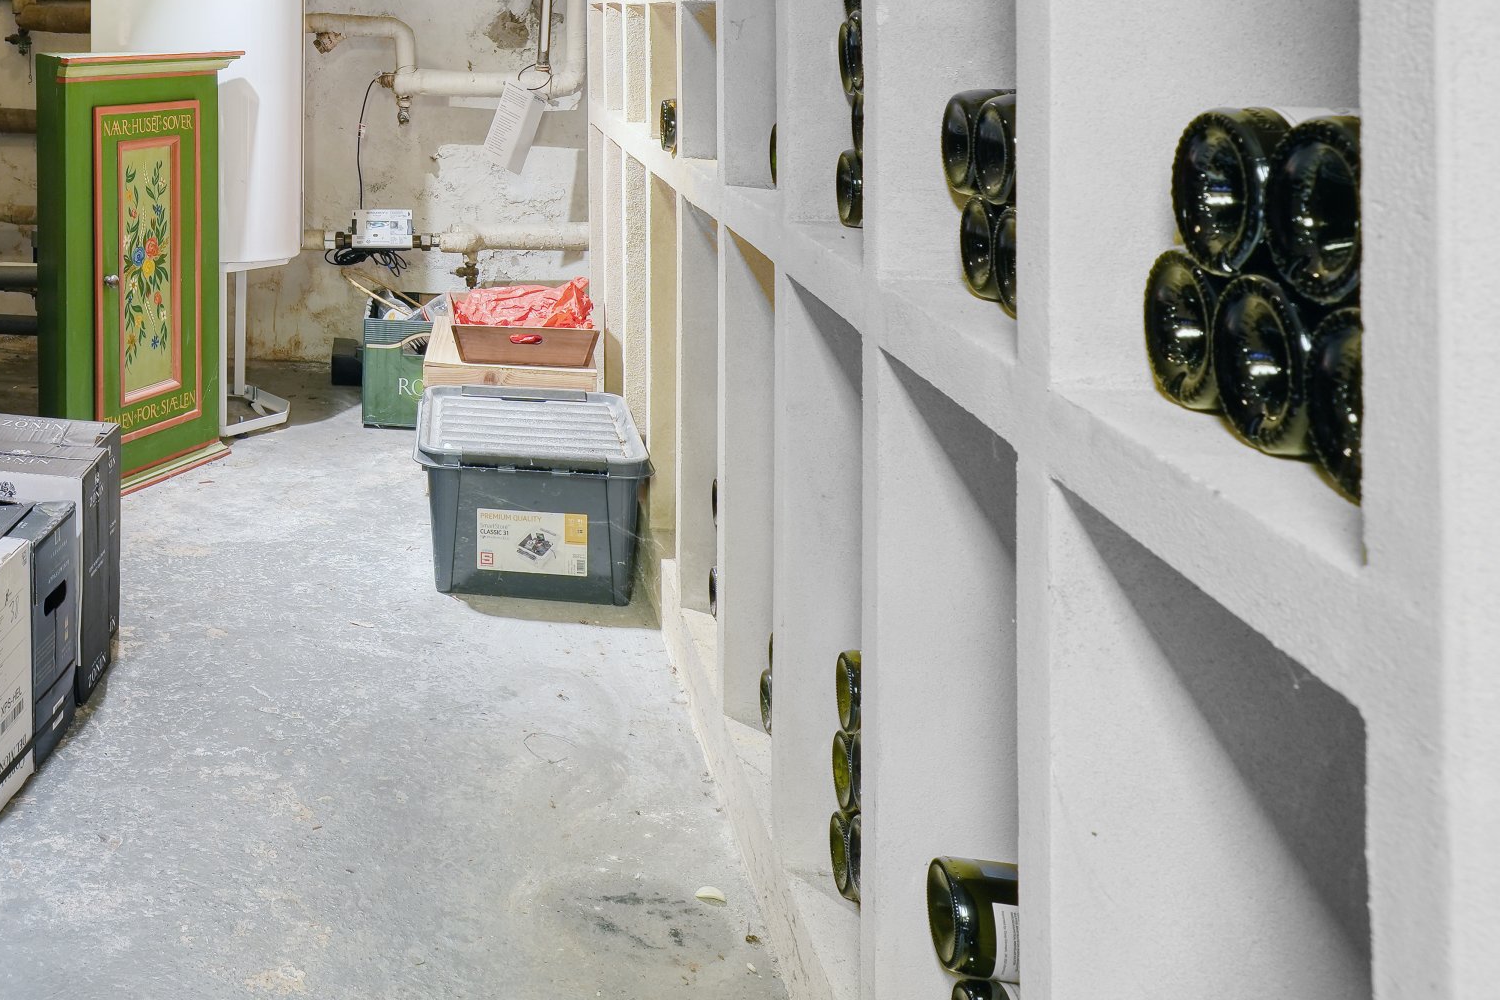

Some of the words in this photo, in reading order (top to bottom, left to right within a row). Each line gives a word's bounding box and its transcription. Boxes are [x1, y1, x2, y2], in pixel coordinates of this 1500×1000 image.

[132, 114, 161, 133] HUSET
[162, 114, 193, 131] SOVER
[398, 377, 425, 397] RO
[136, 404, 160, 423] FOR
[2, 419, 66, 431] ZONIN
[480, 513, 512, 521] PREMIUM
[480, 528, 502, 536] CLASSIC
